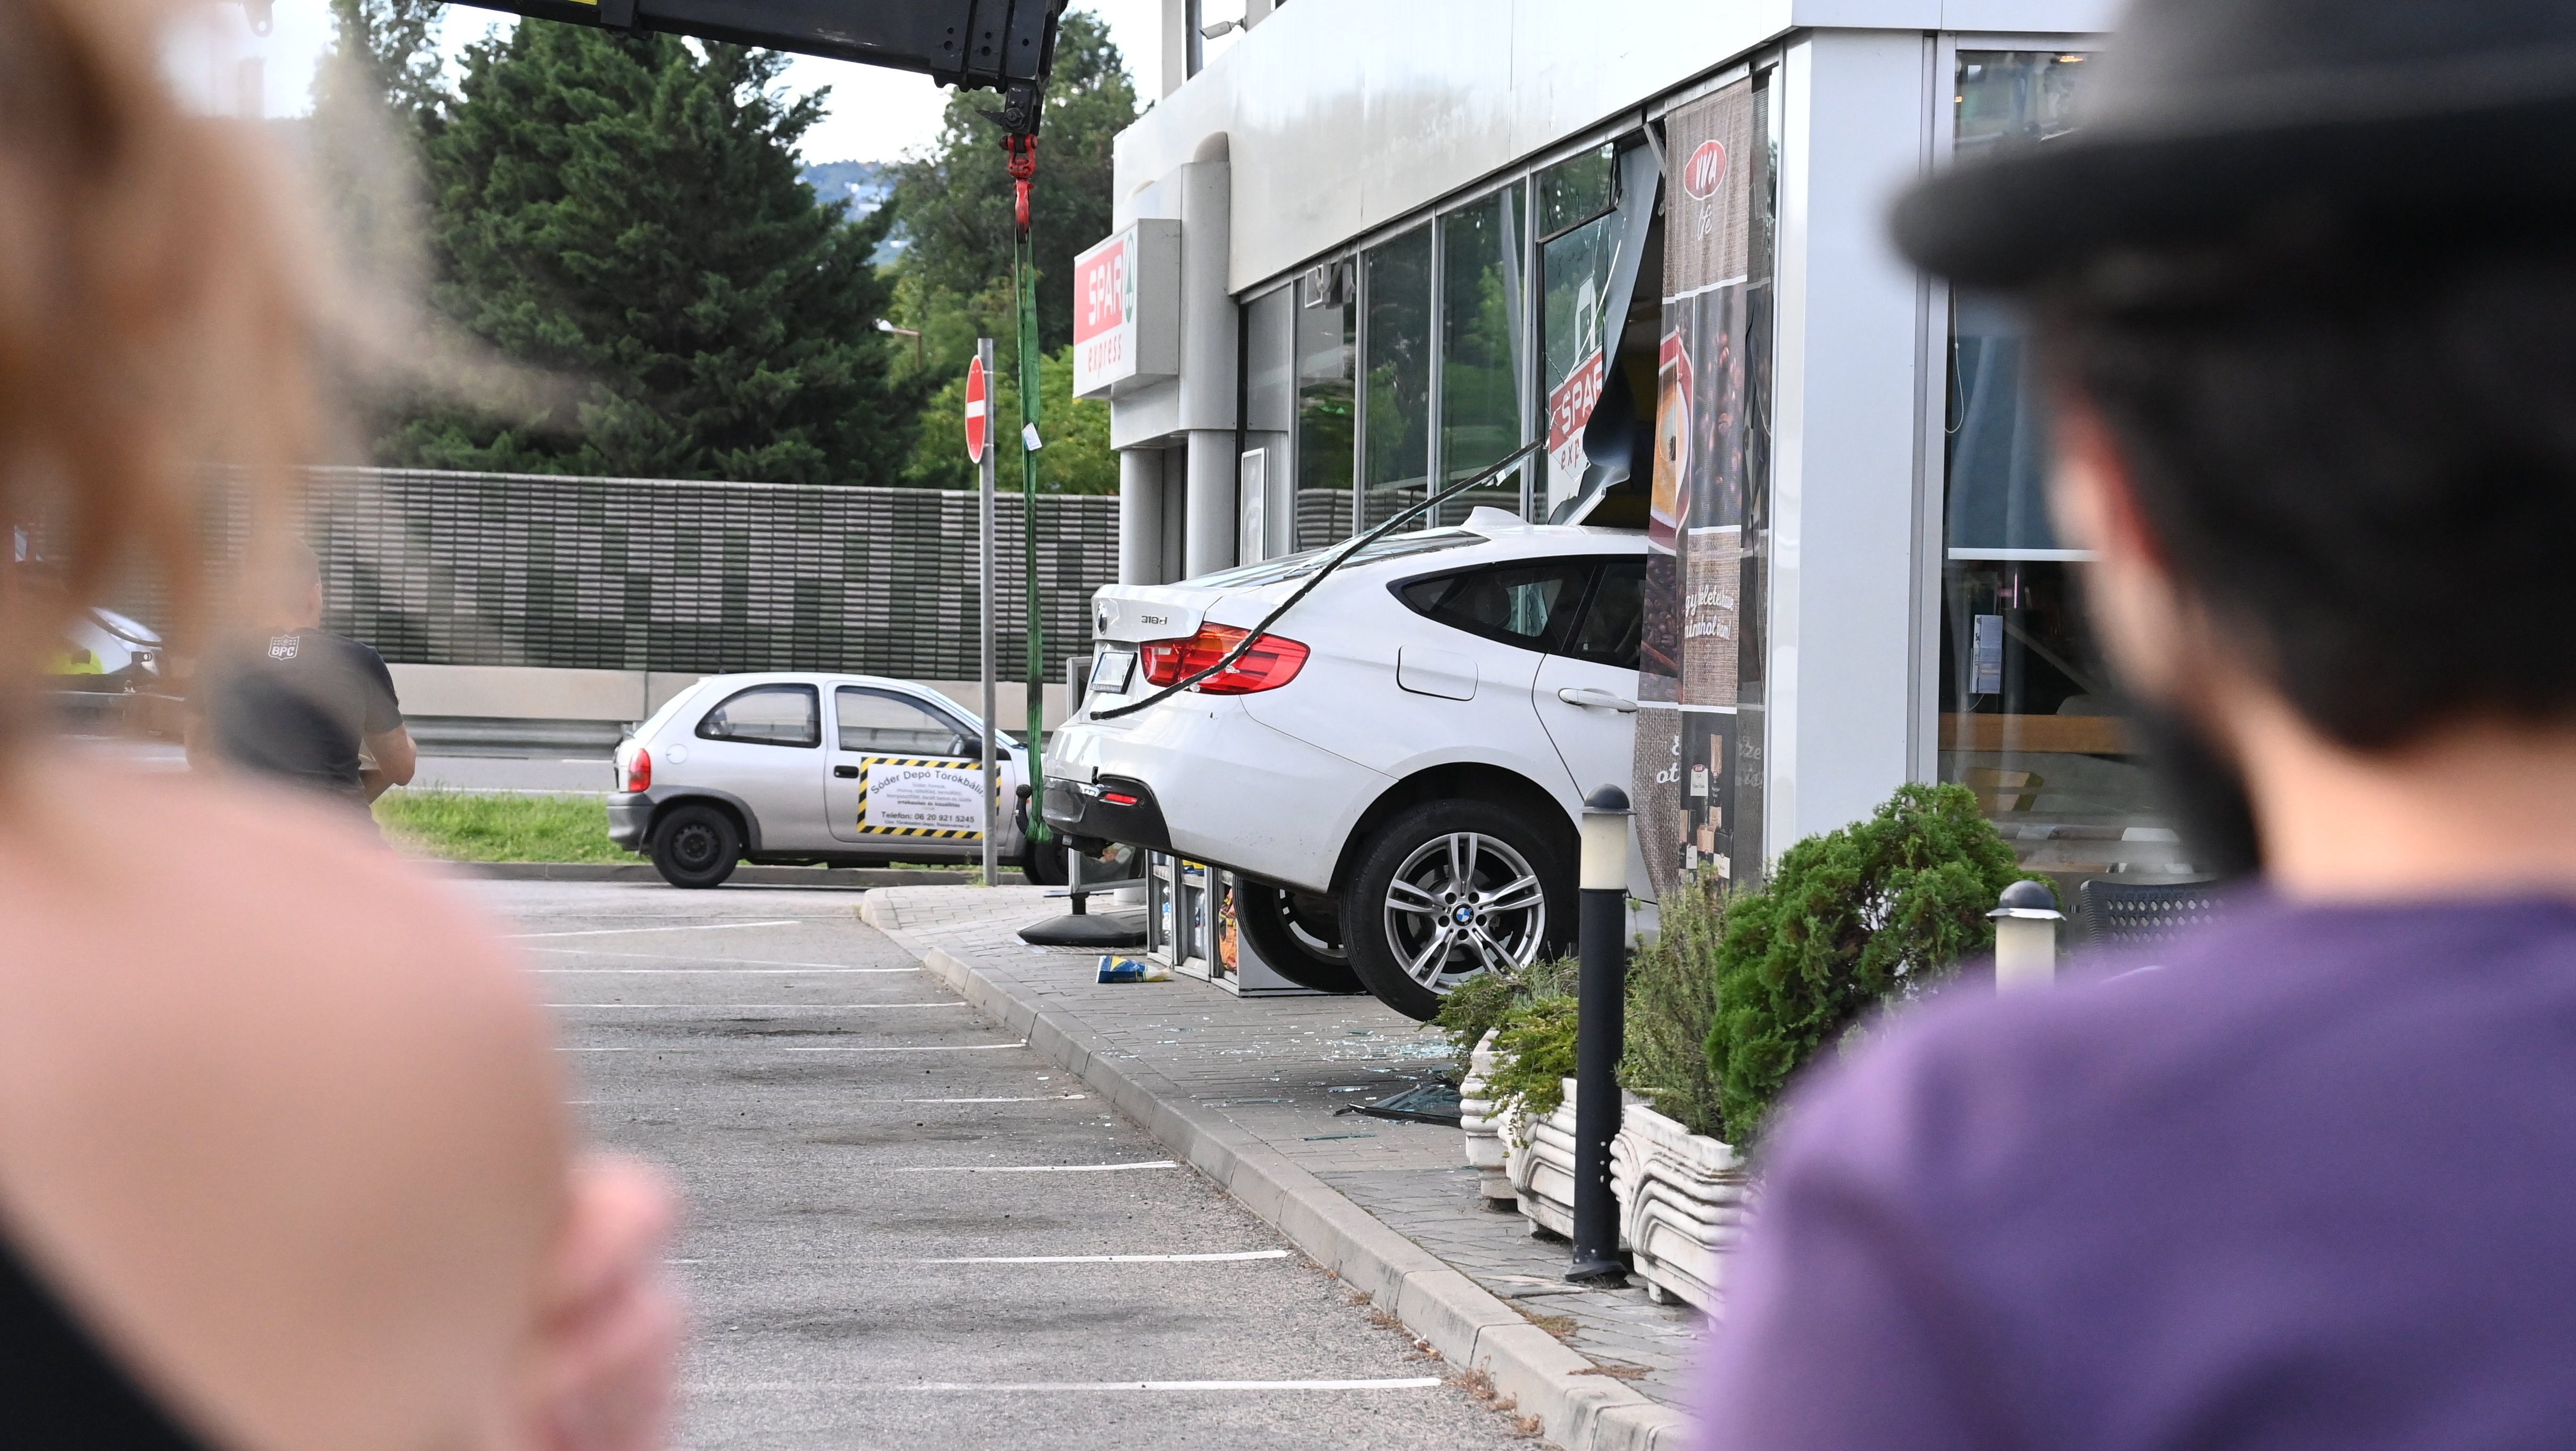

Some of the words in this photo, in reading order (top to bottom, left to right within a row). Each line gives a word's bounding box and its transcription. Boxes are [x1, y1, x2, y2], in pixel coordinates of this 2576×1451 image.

[1089, 254, 1123, 326] SPAR
[1088, 333, 1122, 379] express
[272, 646, 295, 657] BPC
[903, 769, 931, 780] Depó
[934, 770, 983, 798] Törökbáli
[881, 811, 912, 820] Telefon:
